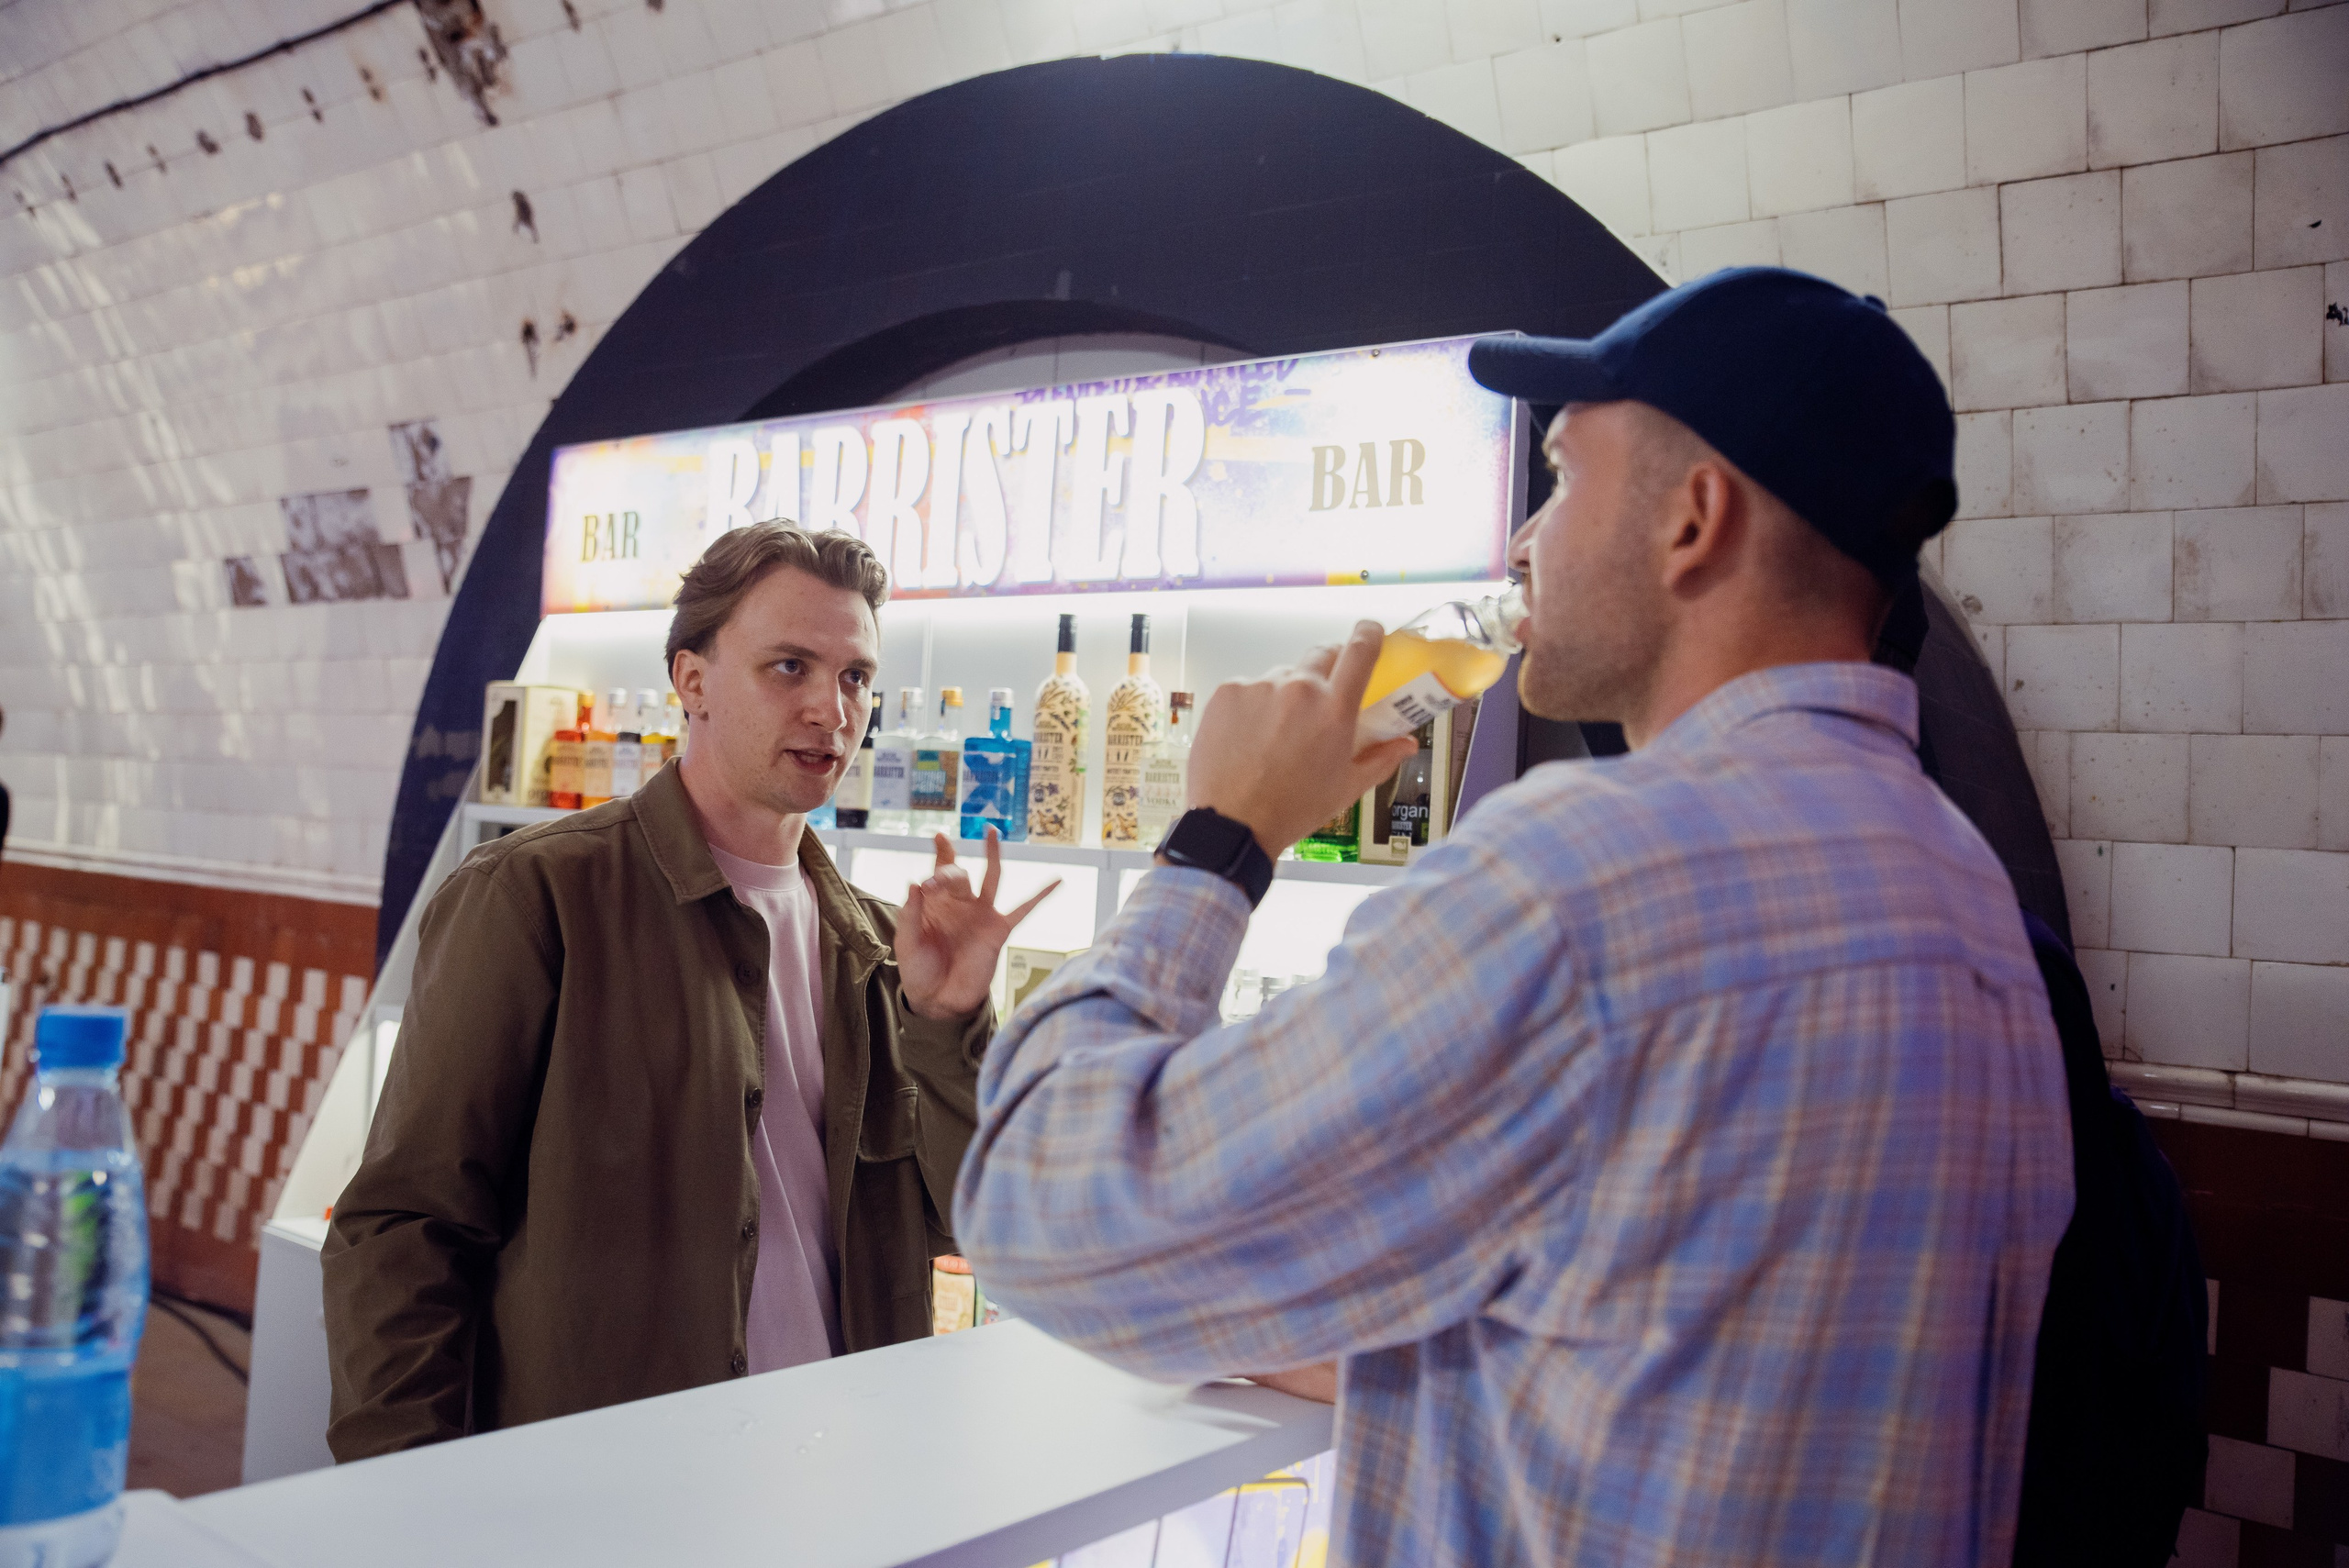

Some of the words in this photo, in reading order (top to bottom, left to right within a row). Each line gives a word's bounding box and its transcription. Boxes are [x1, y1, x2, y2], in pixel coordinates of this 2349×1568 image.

[705, 386, 1206, 591] BARRISTER
[1308, 439, 1425, 512] BAR
[581, 511, 640, 562] BAR
[1144, 771, 1180, 784] BARRISTER
